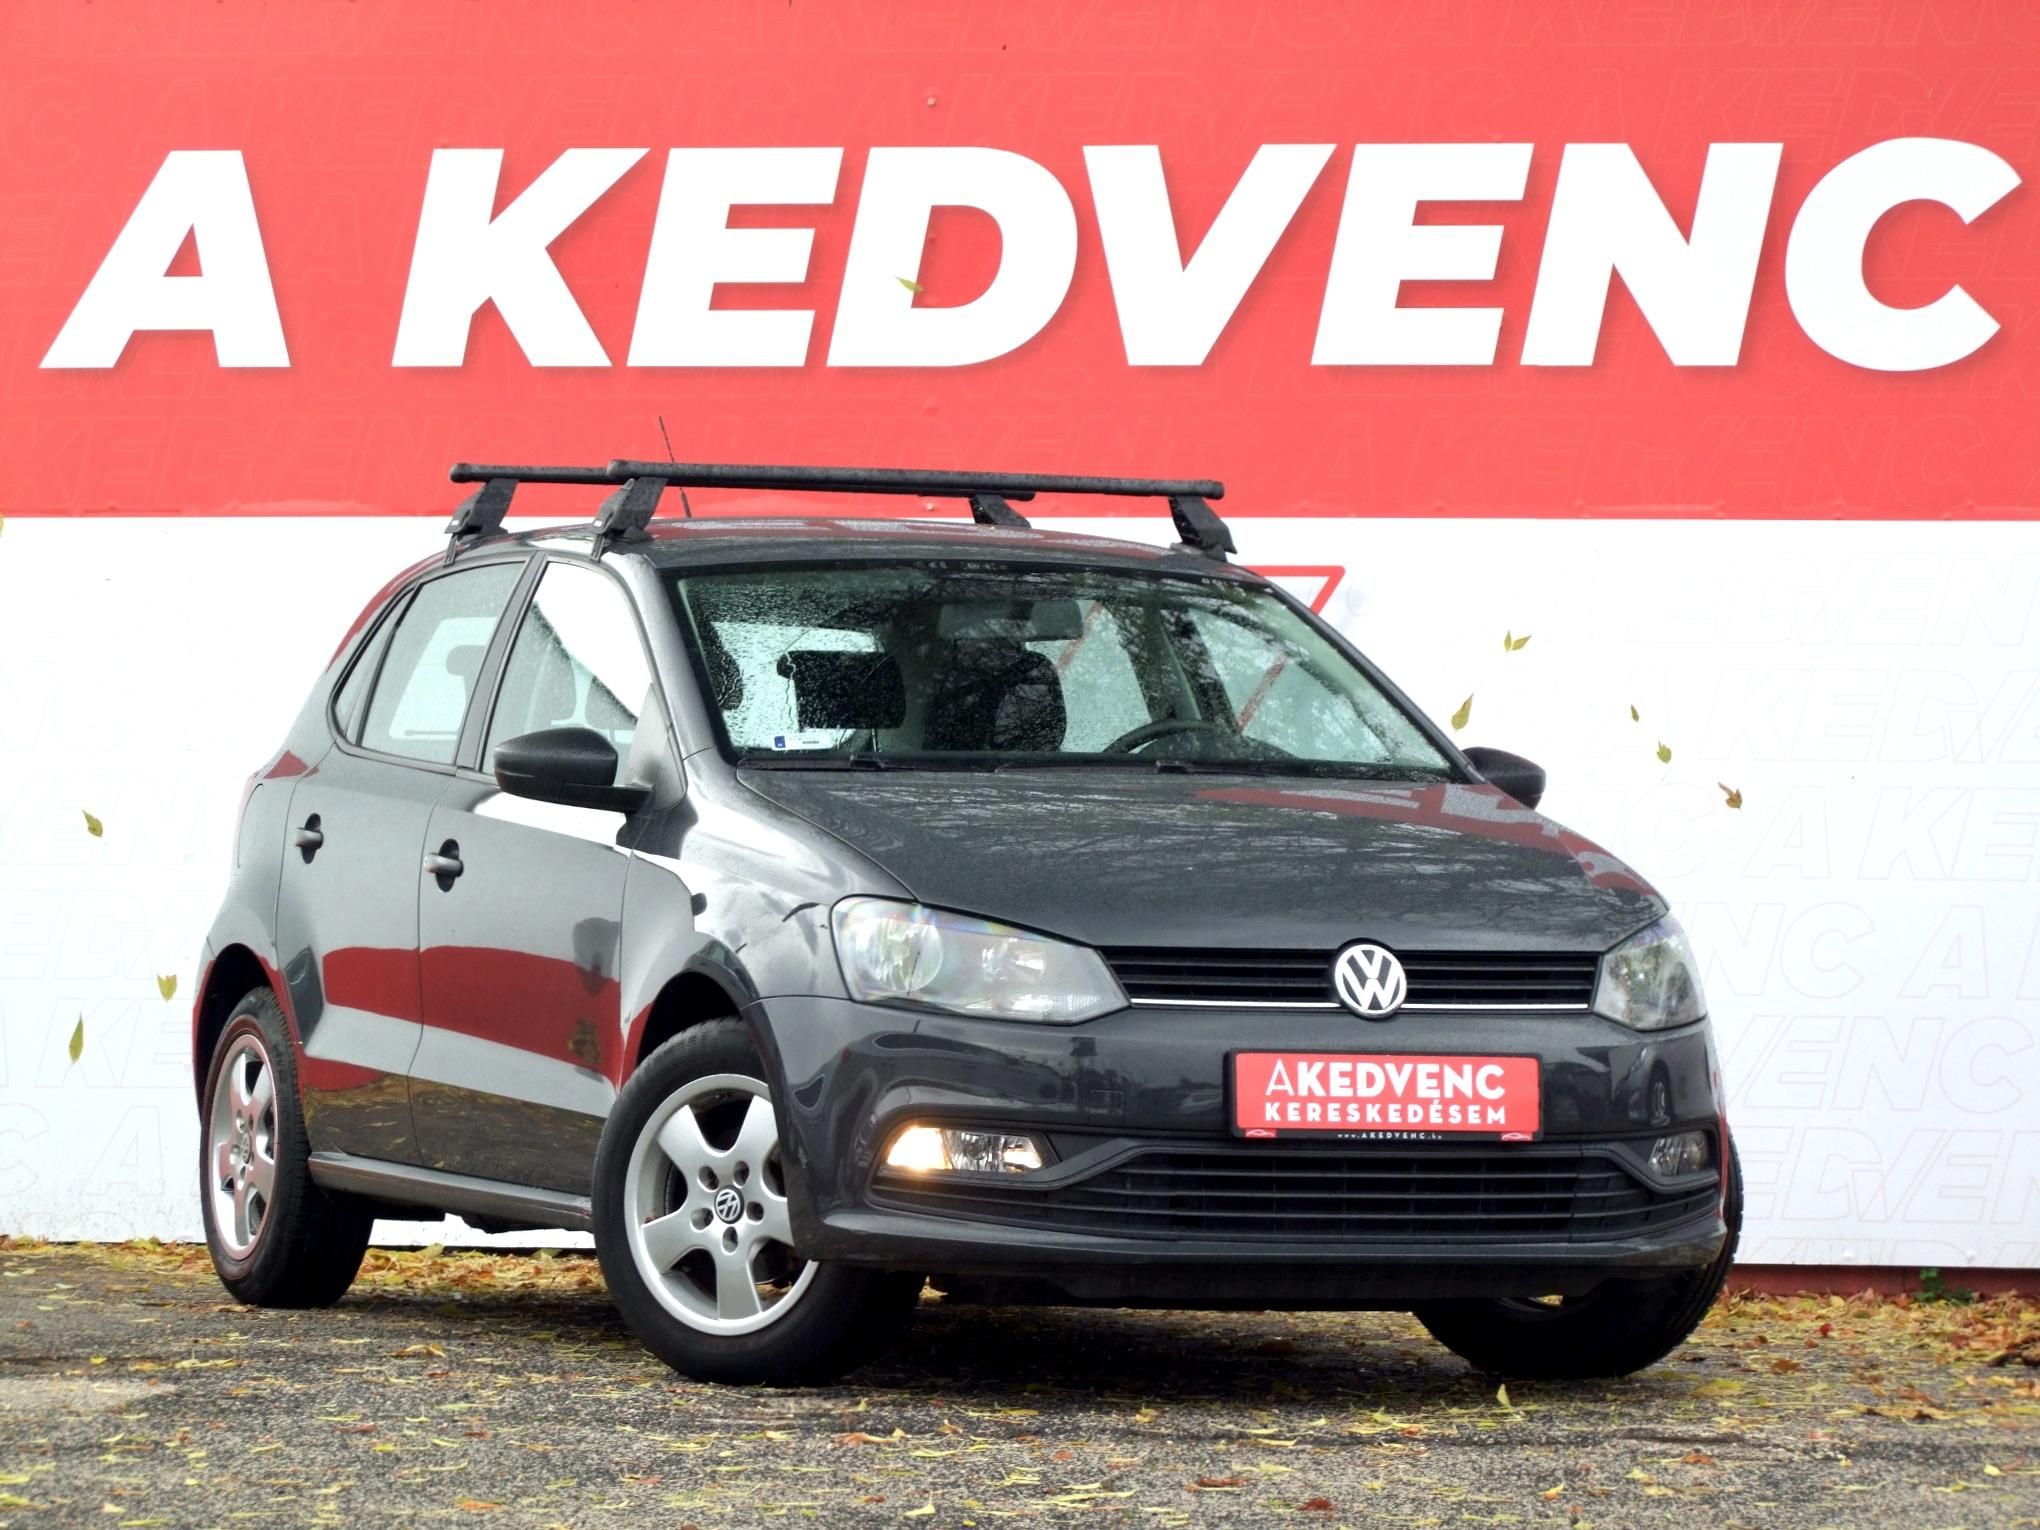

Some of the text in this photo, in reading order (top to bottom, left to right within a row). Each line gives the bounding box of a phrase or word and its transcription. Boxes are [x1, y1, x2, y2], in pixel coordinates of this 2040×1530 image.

[37, 136, 2023, 372] A KEDVENC
[1335, 944, 1407, 1013] VW
[1264, 1057, 1505, 1101] AKEDVENC
[1264, 1099, 1506, 1125] KERESKEDÉSEM
